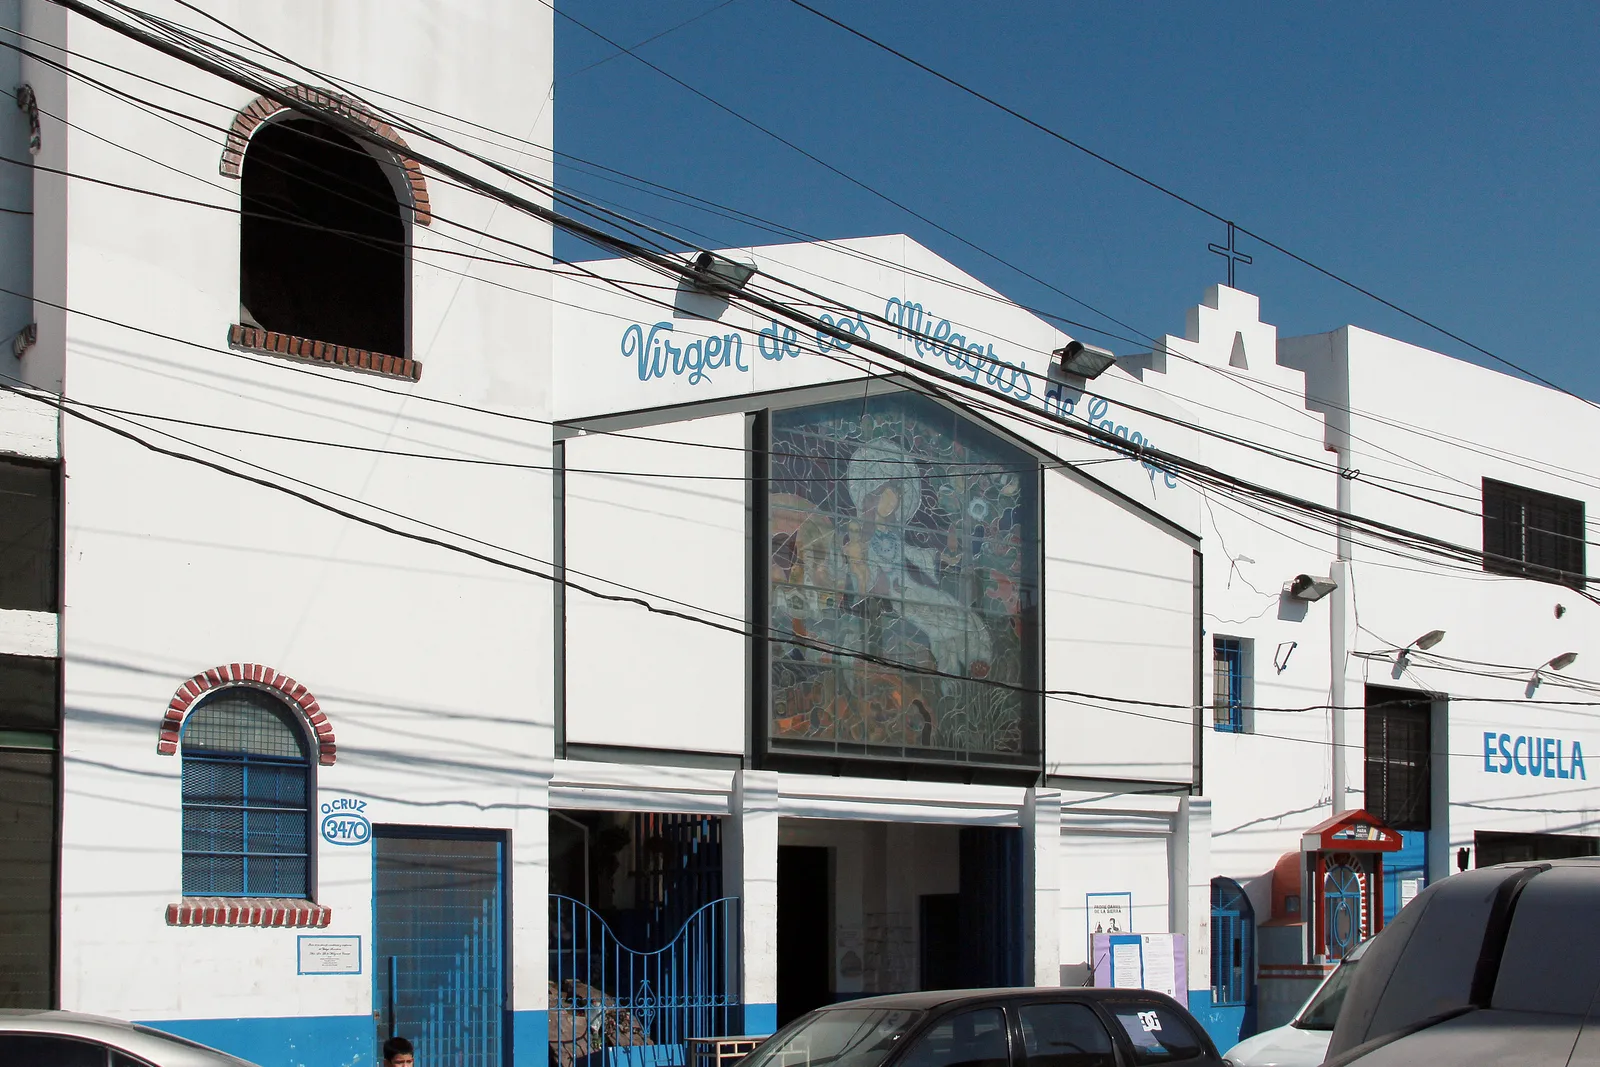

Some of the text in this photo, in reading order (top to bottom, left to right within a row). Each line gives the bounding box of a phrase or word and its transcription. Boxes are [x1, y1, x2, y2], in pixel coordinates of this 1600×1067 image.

[621, 322, 748, 385] Virgen
[759, 318, 801, 361] de
[885, 297, 1032, 402] Milagros
[1484, 732, 1586, 780] ESCUELA
[326, 819, 368, 840] 3470
